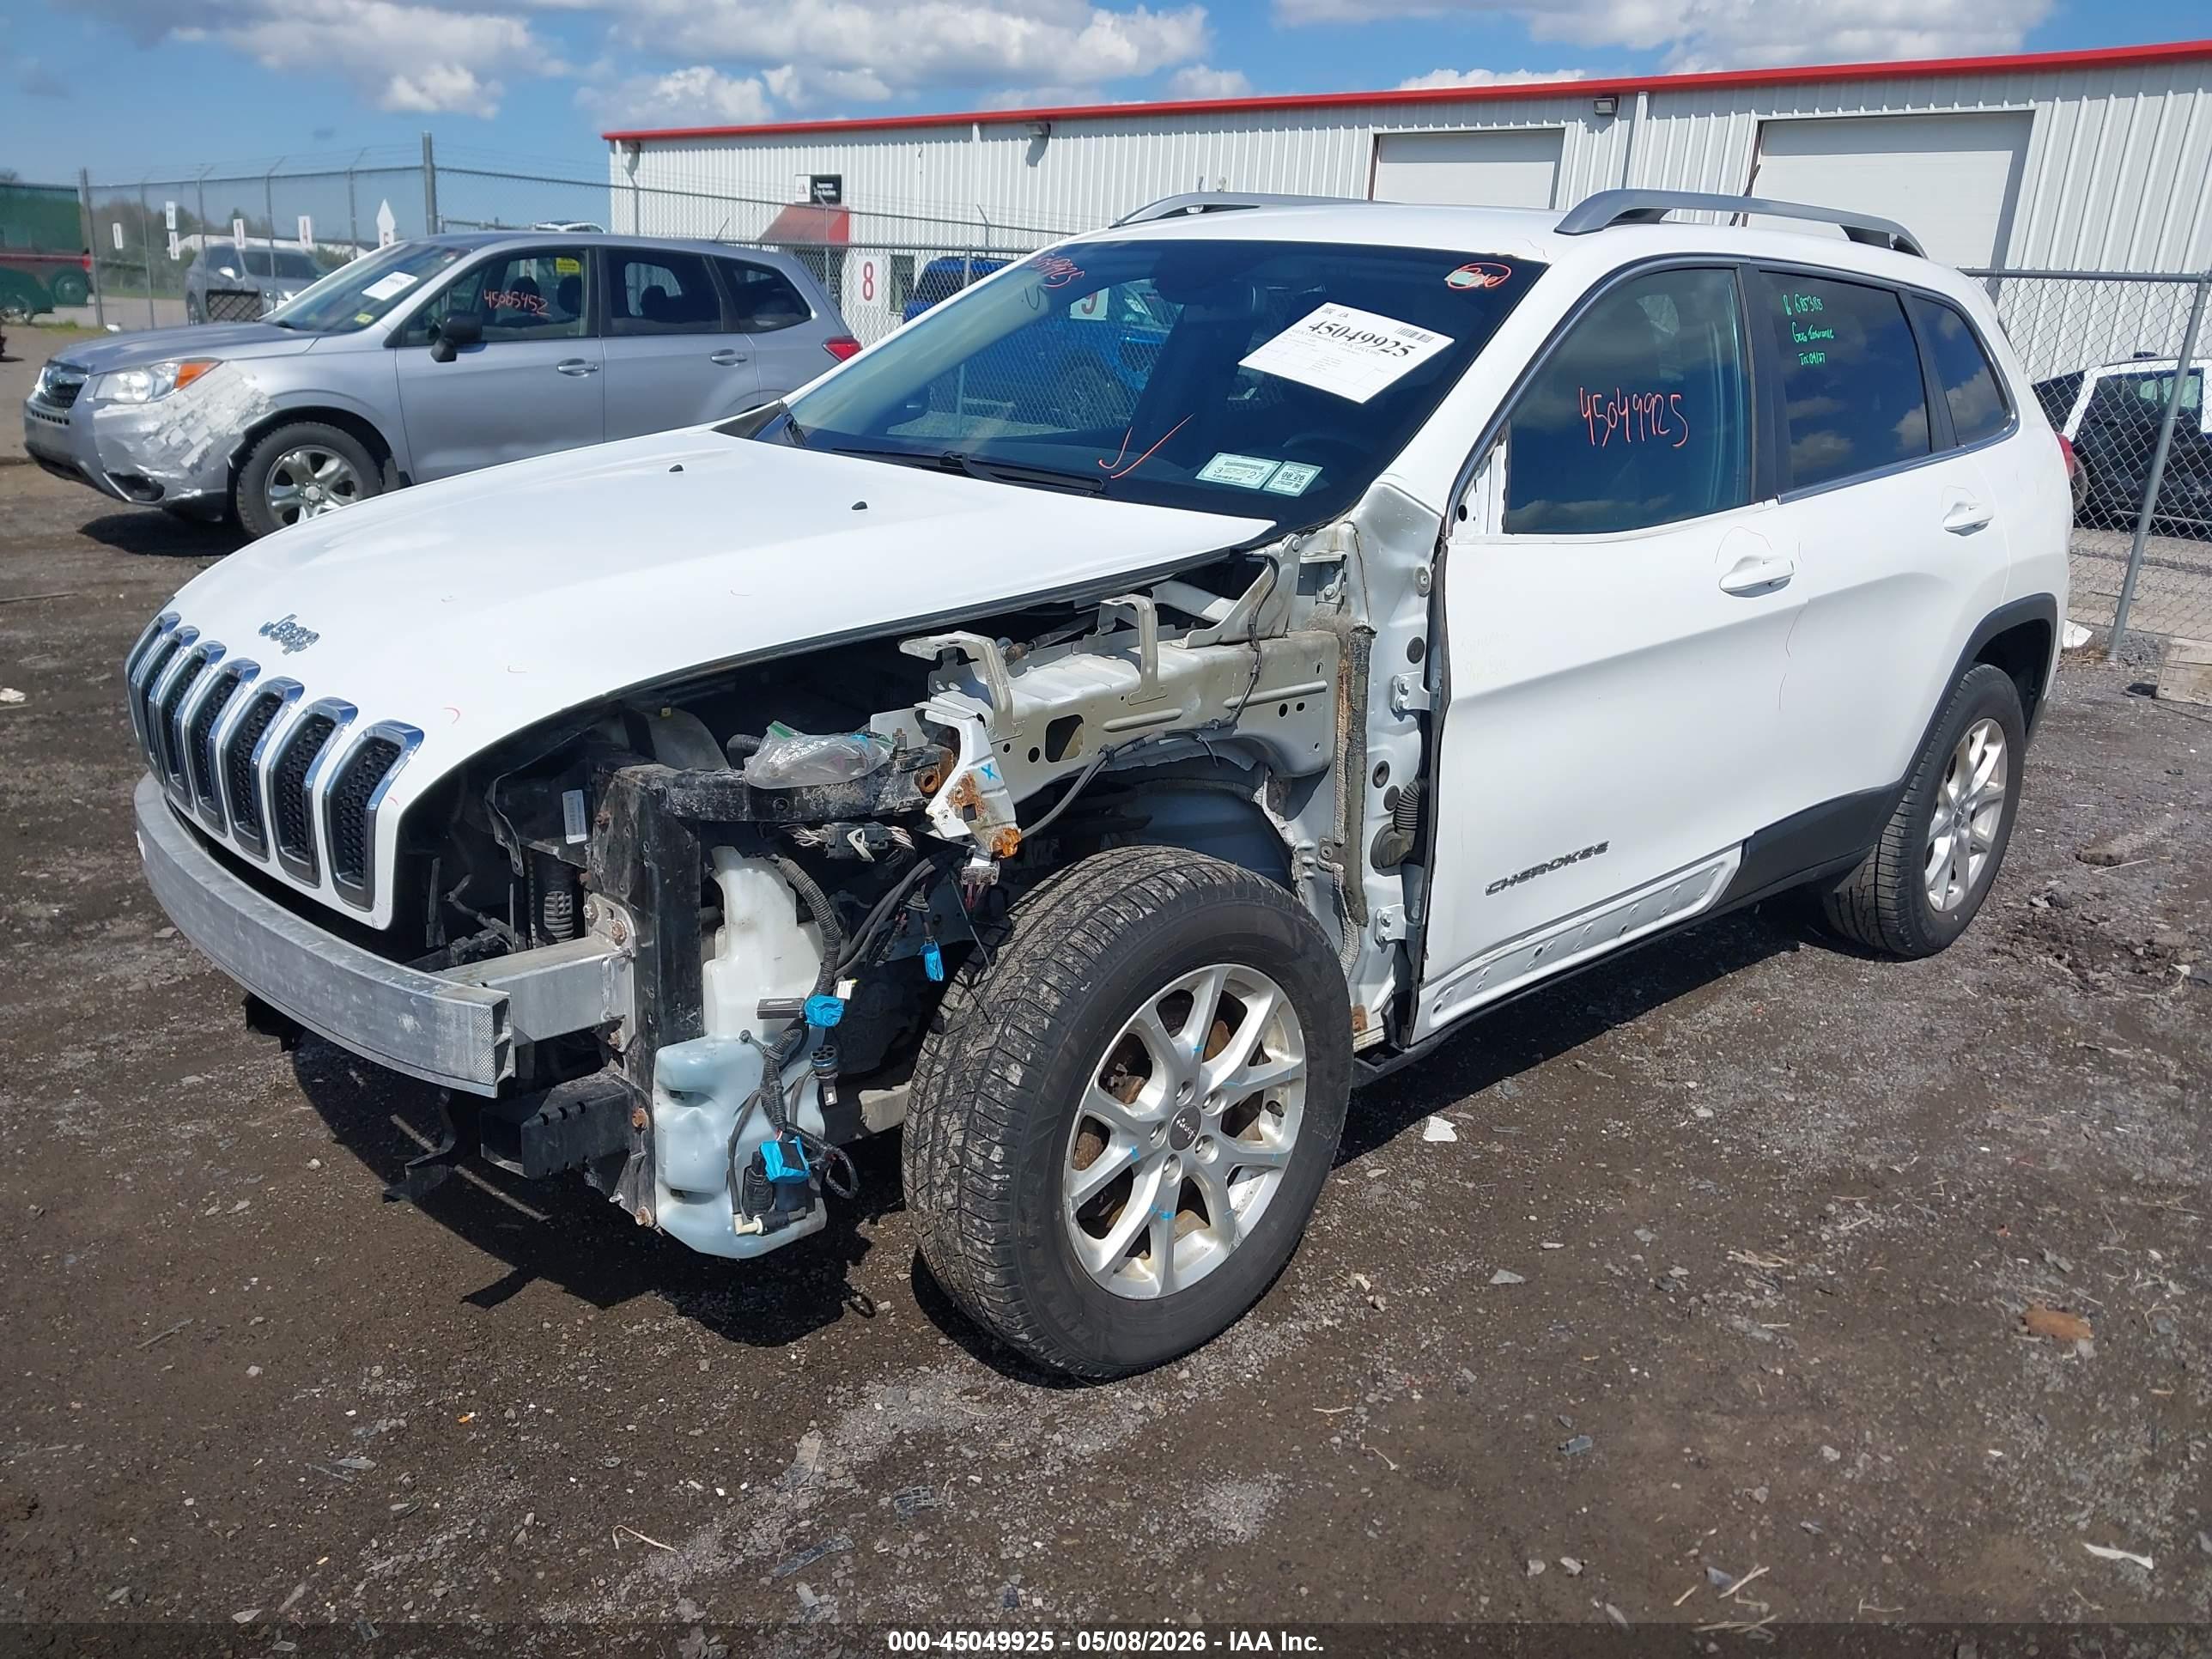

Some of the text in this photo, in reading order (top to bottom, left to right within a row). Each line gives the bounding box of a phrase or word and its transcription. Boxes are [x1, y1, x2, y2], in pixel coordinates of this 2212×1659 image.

[862, 260, 874, 301] 8
[1308, 320, 1417, 357] 45049925
[1579, 386, 1689, 447] 45049925
[258, 613, 320, 656] Jeep
[1486, 841, 1609, 896] CHEROKEE
